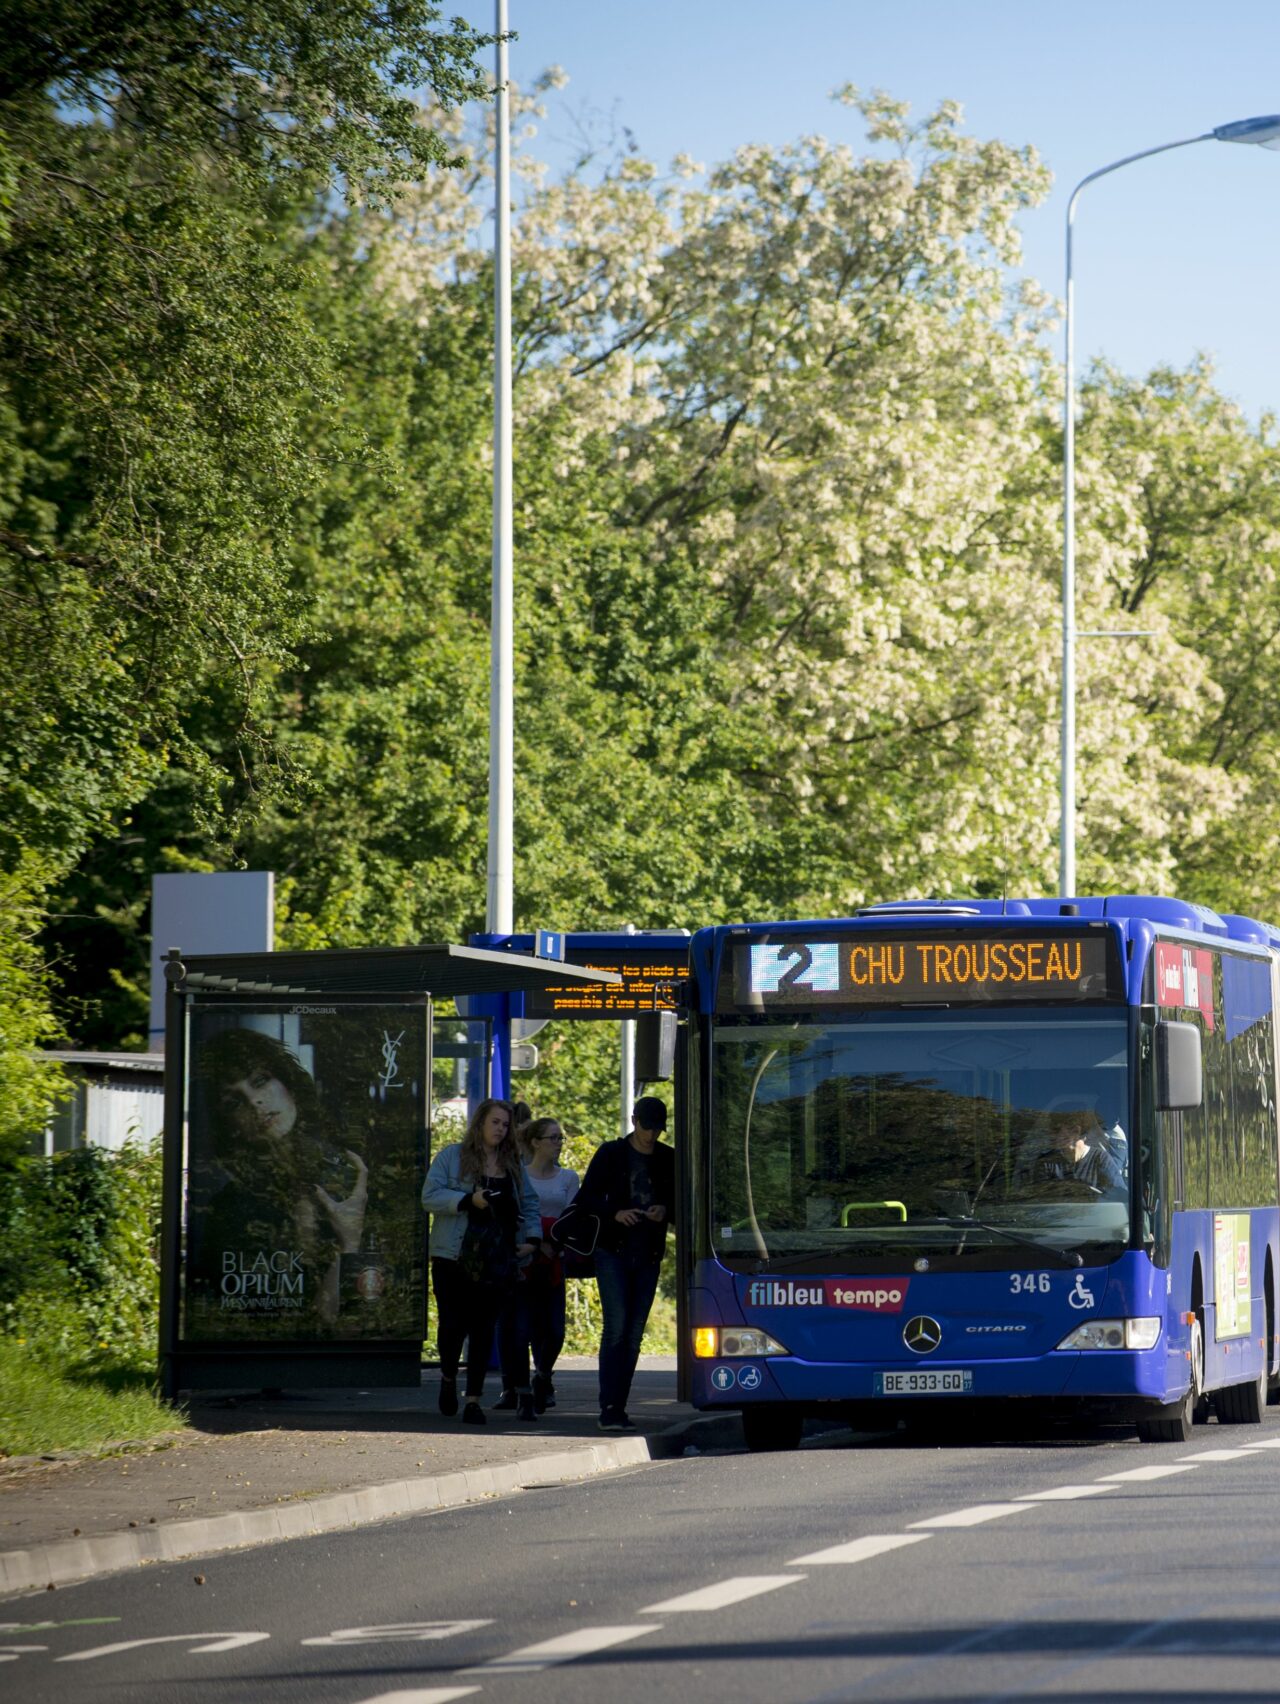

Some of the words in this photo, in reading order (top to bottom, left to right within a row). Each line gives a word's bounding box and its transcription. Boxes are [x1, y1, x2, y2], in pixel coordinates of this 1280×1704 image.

[777, 944, 814, 991] 2
[849, 945, 905, 985] CHU
[916, 942, 1082, 983] TROUSSEAU
[289, 1005, 337, 1015] JCDecaux
[222, 1250, 305, 1273] BLACK
[220, 1272, 304, 1295] OPIUM
[749, 1282, 823, 1306] filbleu
[1009, 1272, 1050, 1294] 346
[833, 1287, 902, 1309] tempo
[965, 1325, 1026, 1333] CITARO
[885, 1374, 961, 1391] BE-933-GQ
[0, 1618, 496, 1663] BU
